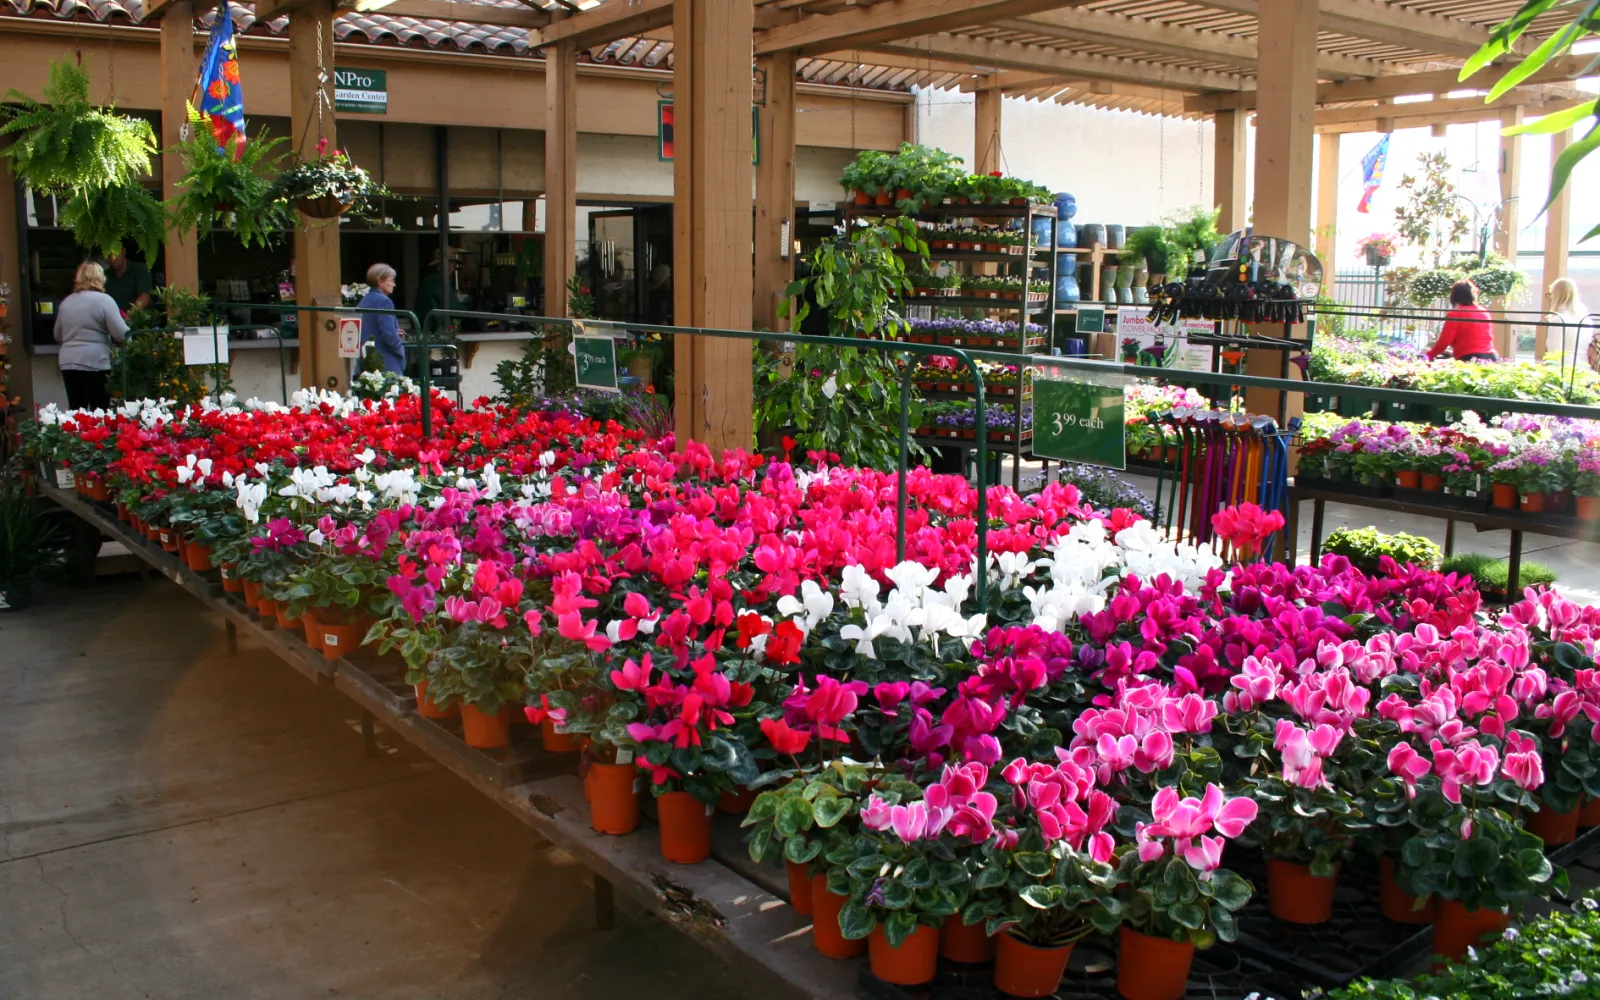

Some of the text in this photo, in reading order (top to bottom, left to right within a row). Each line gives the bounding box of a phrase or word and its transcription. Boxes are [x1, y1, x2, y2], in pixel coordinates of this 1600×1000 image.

[334, 71, 372, 88] NPro
[362, 92, 386, 101] Center
[1122, 315, 1145, 324] Jumbo
[1122, 325, 1145, 333] FLOWER
[1079, 417, 1104, 430] each
